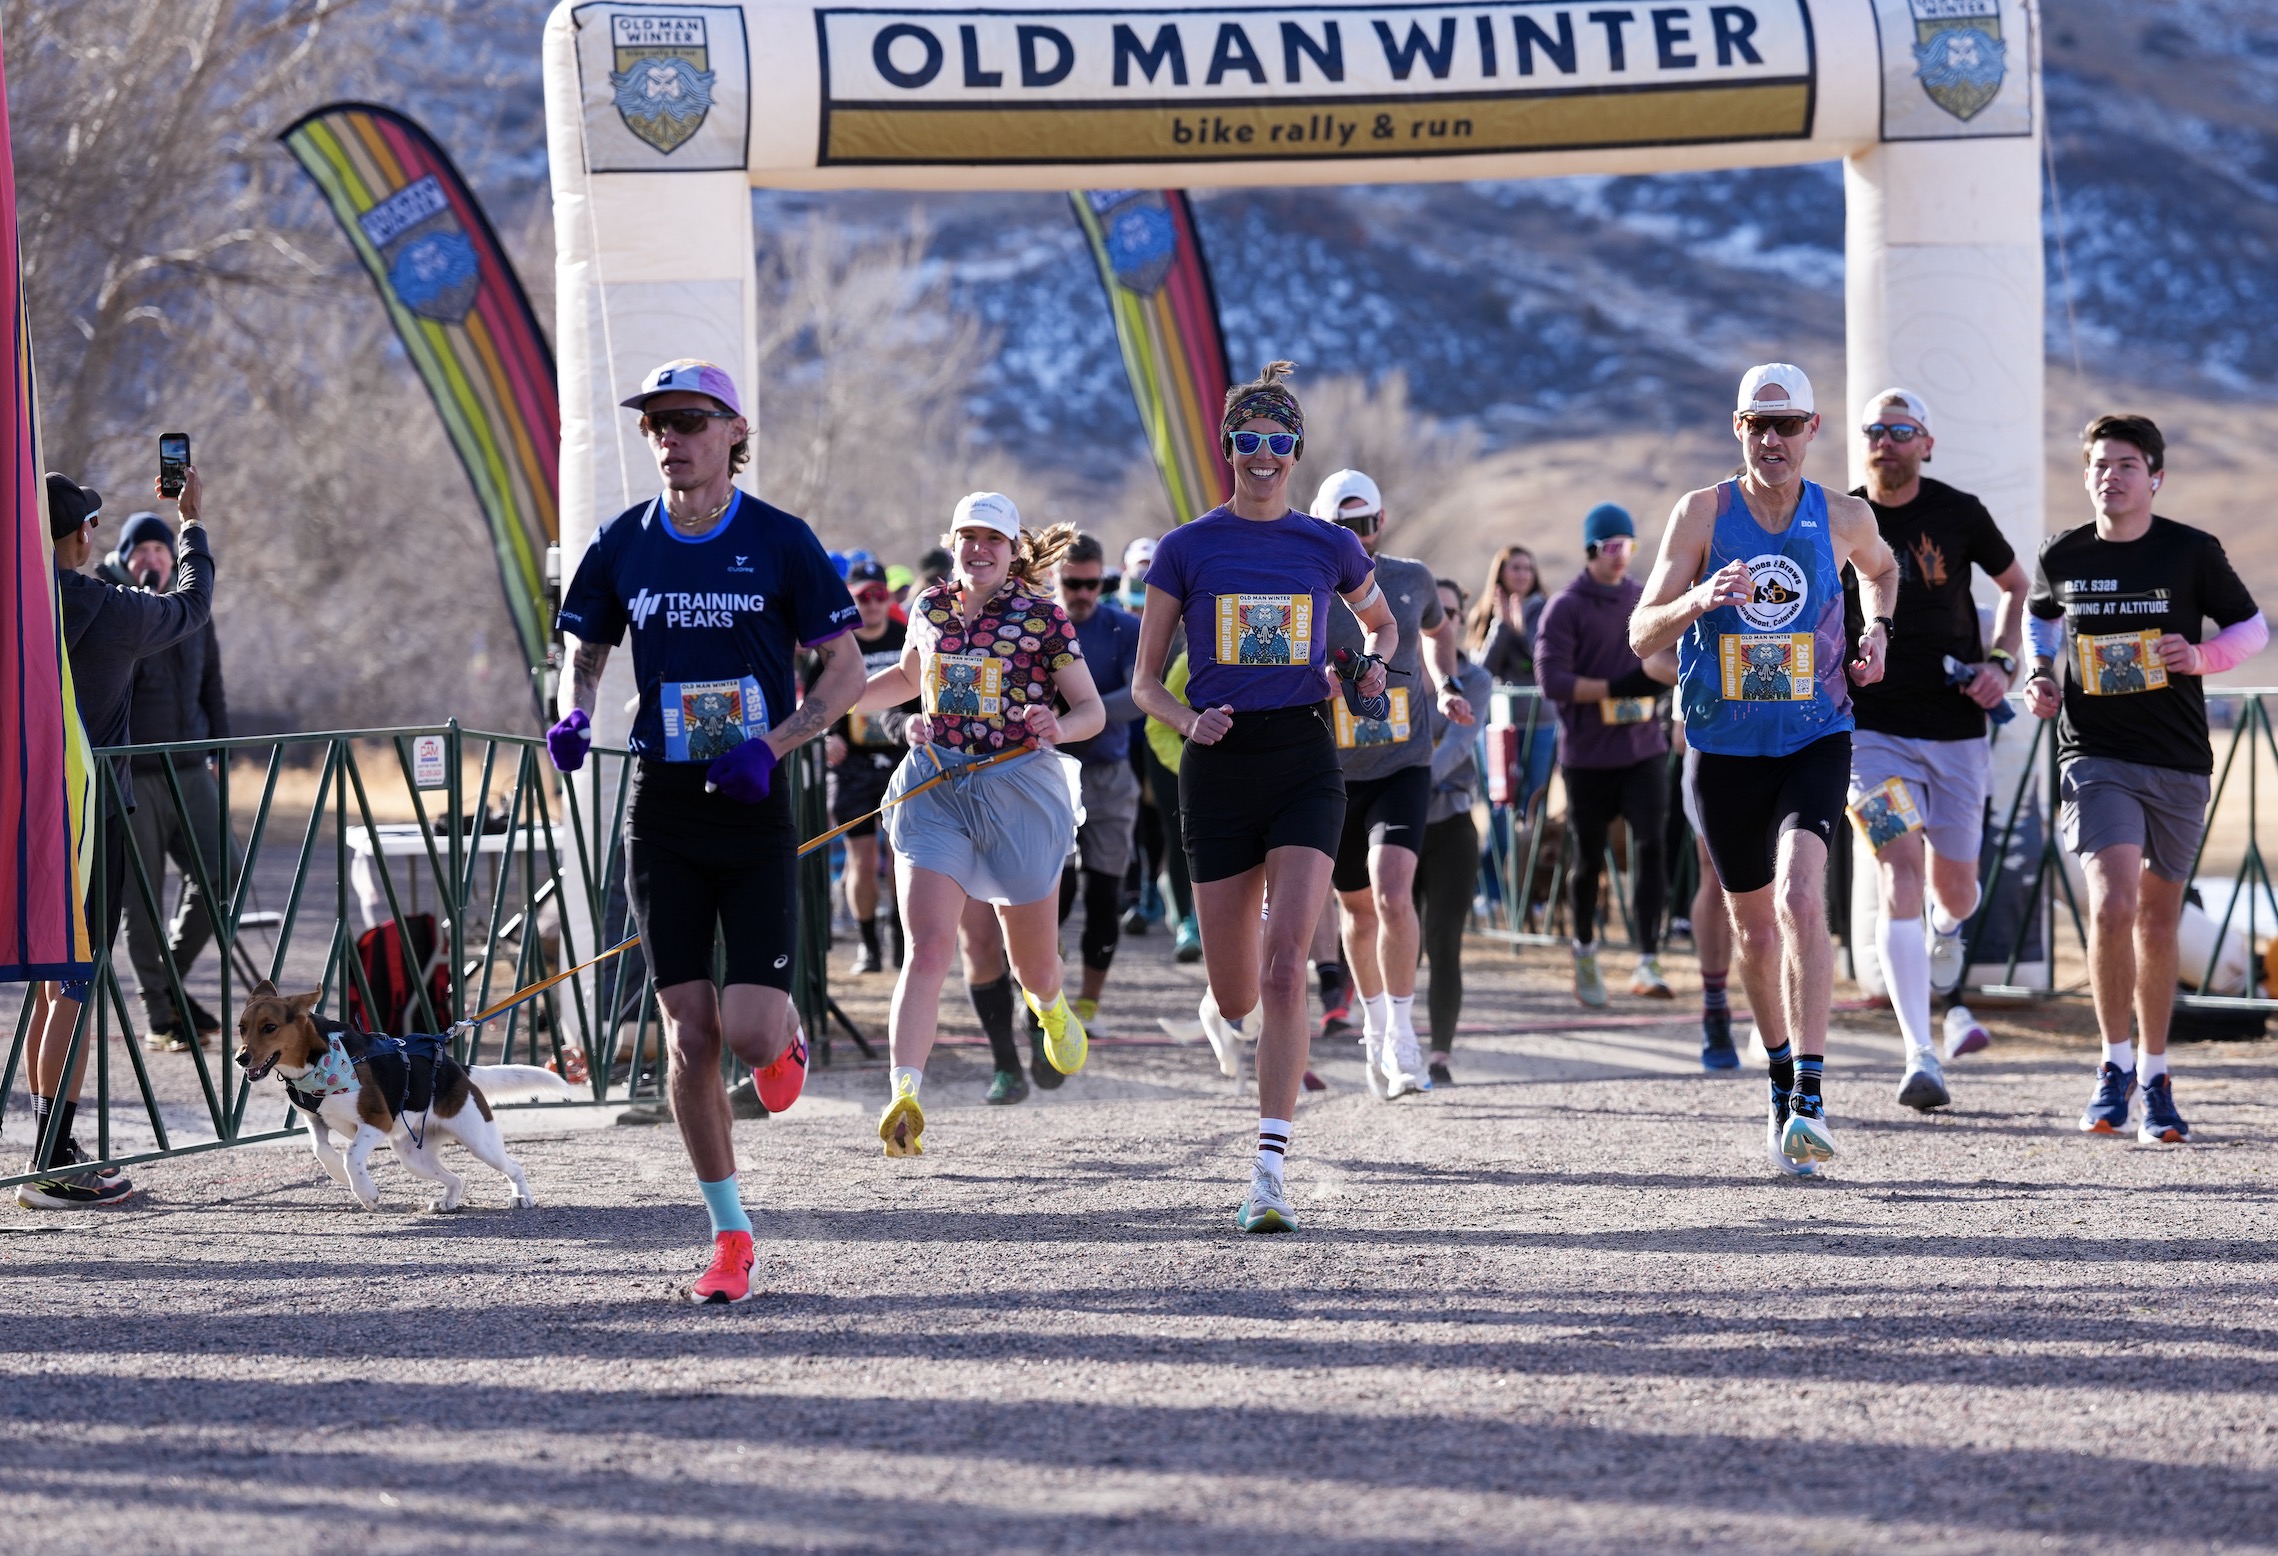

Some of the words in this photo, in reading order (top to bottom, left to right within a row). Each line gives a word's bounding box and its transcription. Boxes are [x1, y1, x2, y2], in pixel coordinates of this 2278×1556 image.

[619, 18, 654, 30] OLD
[659, 20, 699, 31] MAN
[626, 31, 693, 42] WINTER
[872, 22, 1076, 89] OLD
[1112, 20, 1345, 86] MAN
[1371, 6, 1765, 81] WINTER
[1172, 116, 1255, 146] bike
[1269, 113, 1357, 147] rally
[1371, 113, 1396, 140] &
[1410, 115, 1474, 140] run
[1747, 561, 1772, 577] hoes
[1778, 560, 1802, 585] Brews
[1759, 584, 1787, 604] S&B
[2091, 579, 2118, 592] 5328
[664, 592, 764, 612] TRAINING
[1222, 597, 1233, 616] Half
[2103, 602, 2117, 615] AT
[2119, 600, 2169, 614] ALTITUDE
[666, 611, 734, 628] PEAKS
[1296, 604, 1309, 638] 2600
[1740, 605, 1772, 628] ongmont,
[1773, 602, 1800, 627] Colorado
[1222, 617, 1233, 661] Marathon
[1724, 637, 1735, 654] Half
[1796, 643, 1810, 673] 2601
[712, 680, 738, 688] WINTER
[985, 667, 998, 694] 2591
[1725, 655, 1736, 697] Marathon
[745, 685, 763, 722] 2658
[663, 708, 679, 737] Run
[420, 745, 439, 757] CAM
